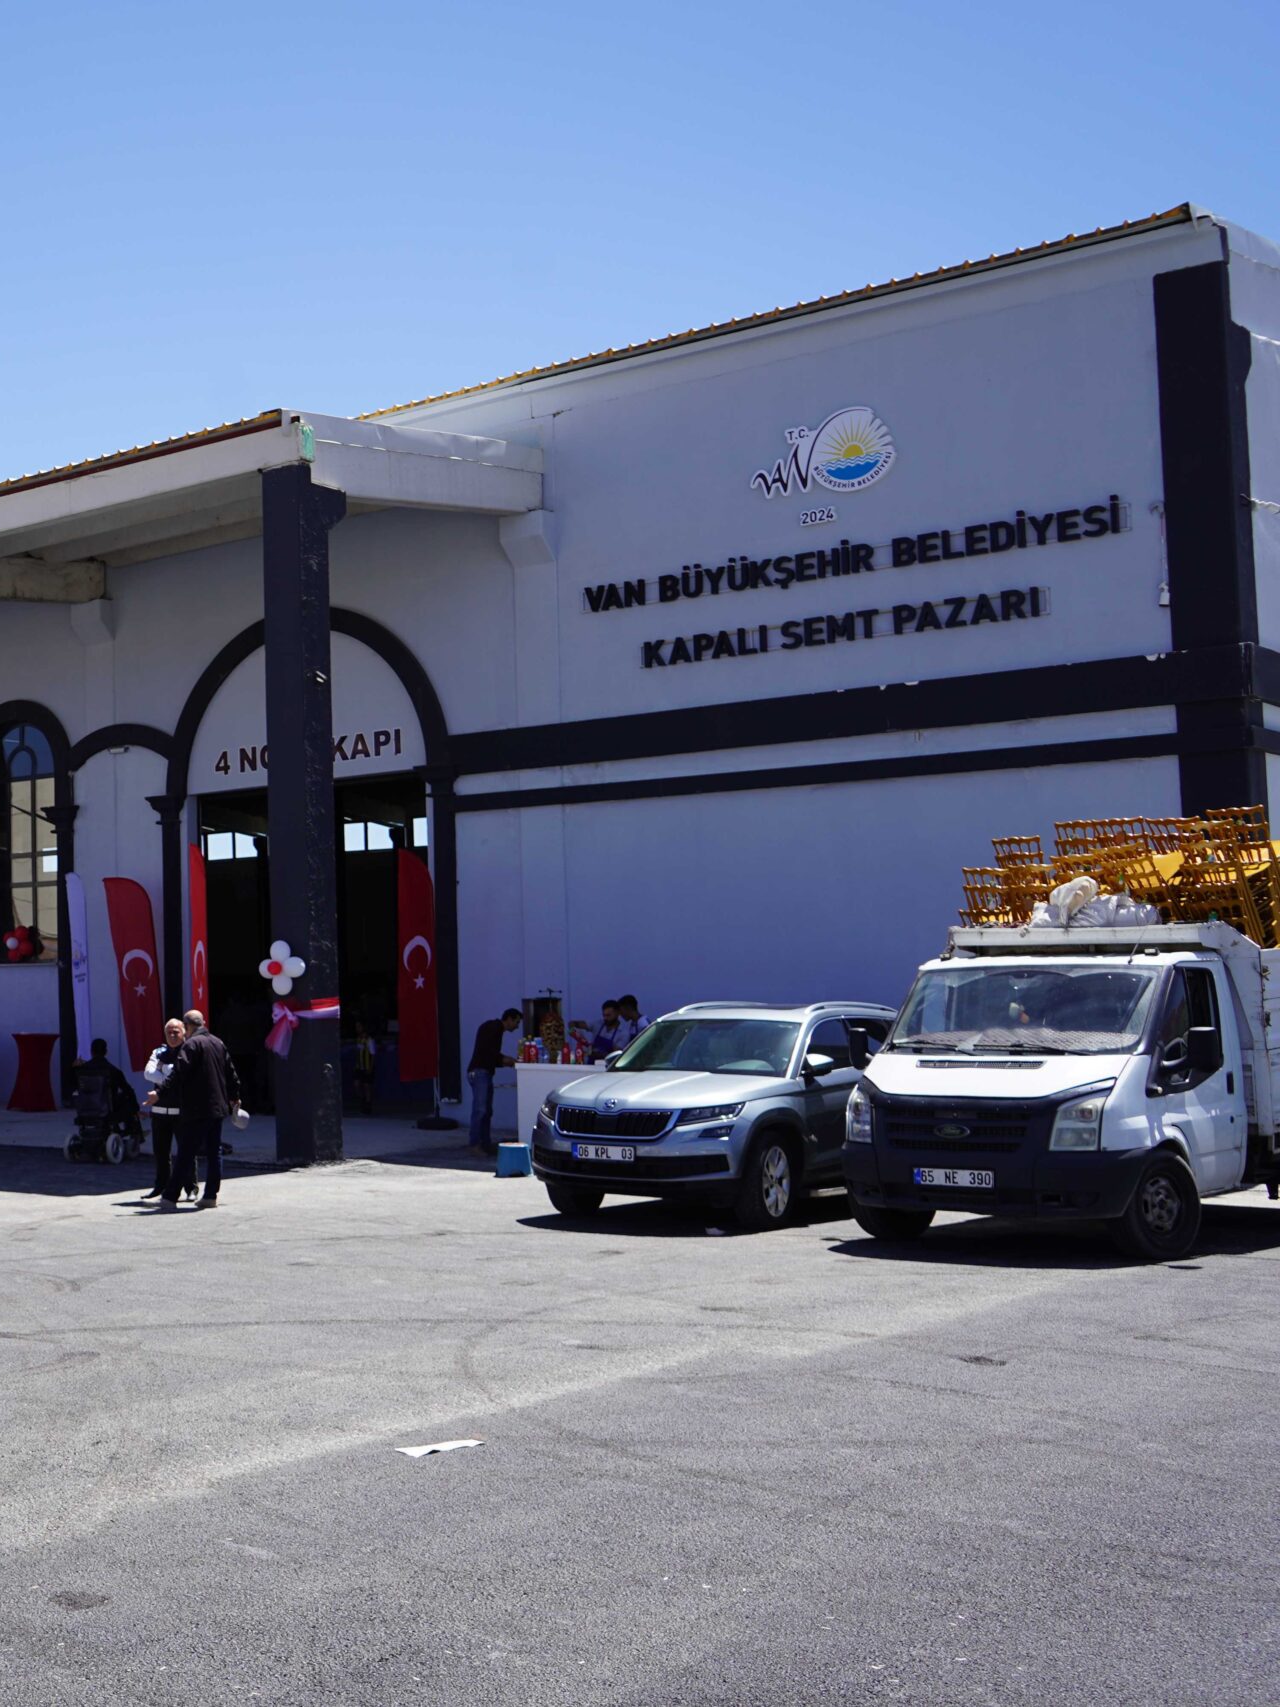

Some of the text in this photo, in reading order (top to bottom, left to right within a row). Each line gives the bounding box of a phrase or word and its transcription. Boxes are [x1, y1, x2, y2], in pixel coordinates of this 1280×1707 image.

[787, 428, 809, 441] T.C.
[813, 451, 893, 489] BÜYÜKŞEHİR BELEDİYESİ
[801, 507, 834, 525] 2024
[583, 494, 1122, 613] VAN BÜYÜKŞEHİR BELEDİYESİ
[643, 586, 1040, 669] KAPALI SEMT PAZARI
[215, 751, 231, 775] 4
[578, 1146, 633, 1160] 06 KPL 03
[921, 1170, 991, 1186] 65 NE 390
